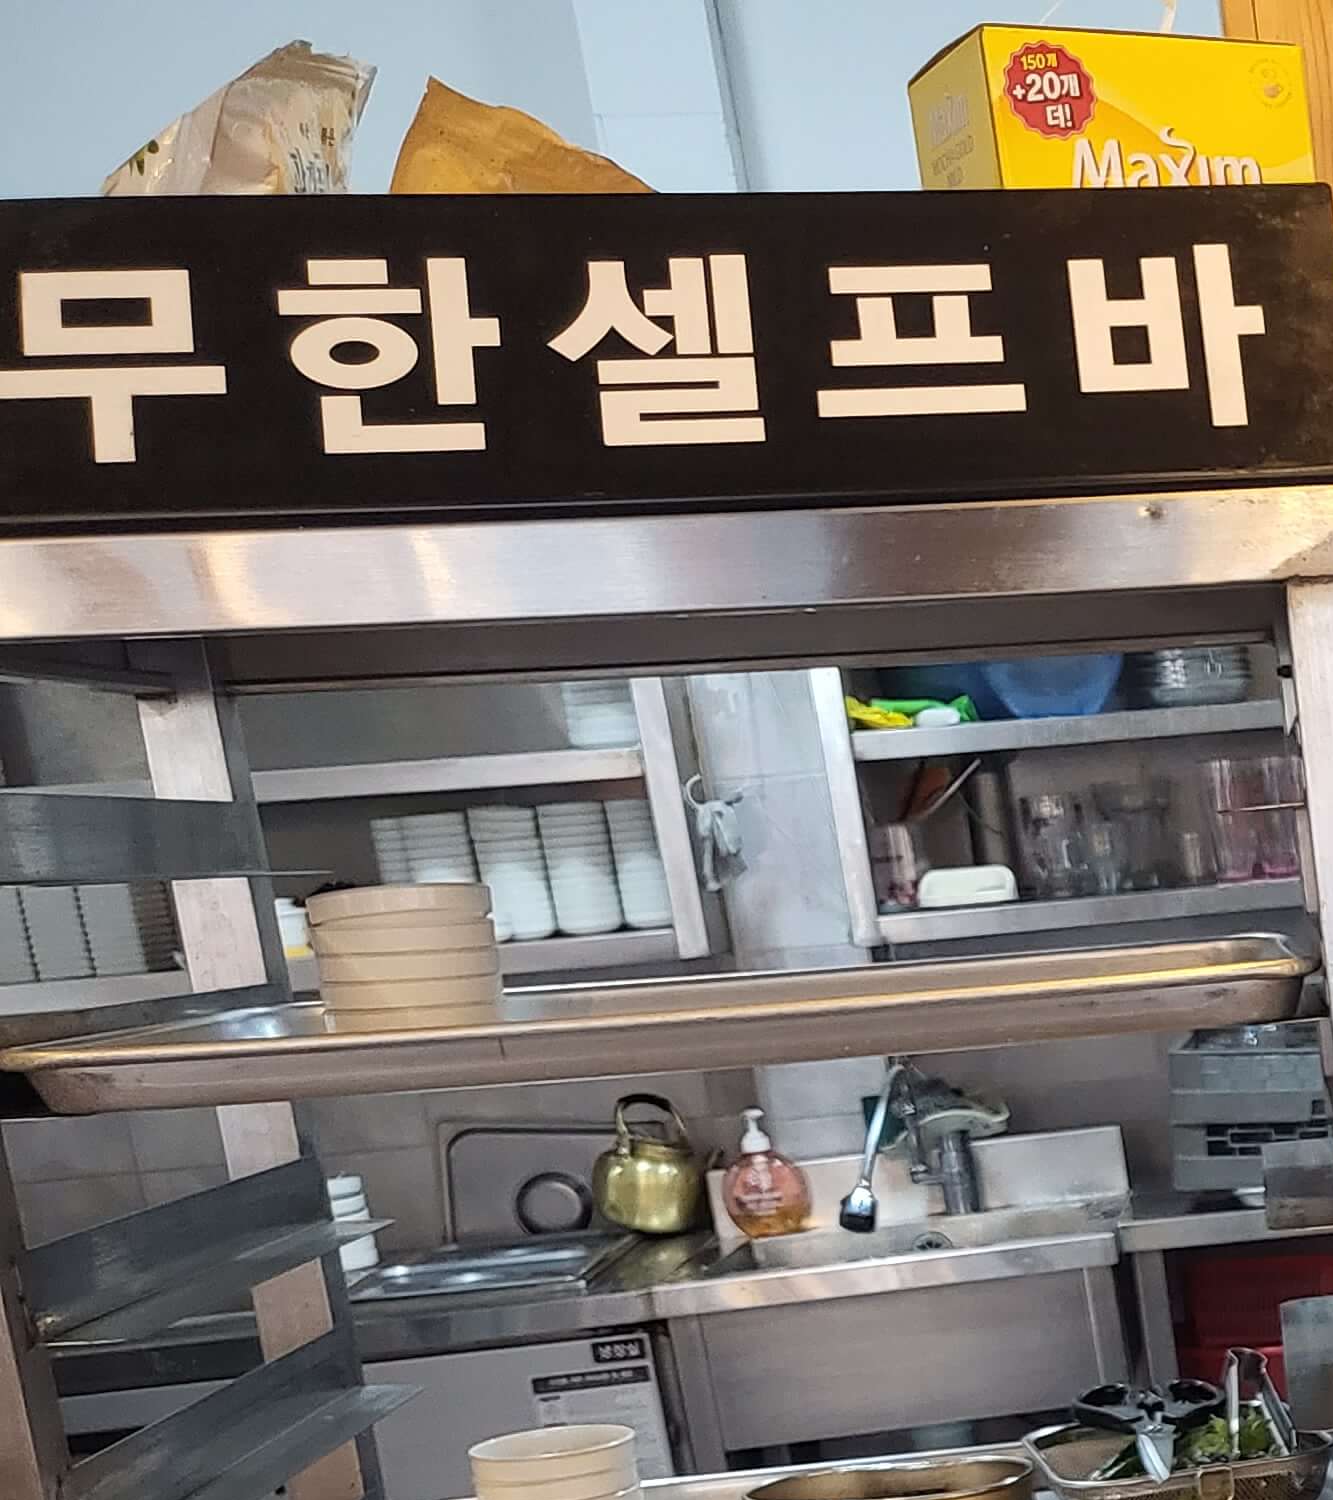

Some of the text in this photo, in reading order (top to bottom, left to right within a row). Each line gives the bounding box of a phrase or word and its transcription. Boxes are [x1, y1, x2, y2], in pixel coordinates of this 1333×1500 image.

[1020, 53, 1058, 71] 150개
[1012, 72, 1081, 103] +20개
[1045, 104, 1074, 129] 더!
[1073, 127, 1262, 187] Maxim
